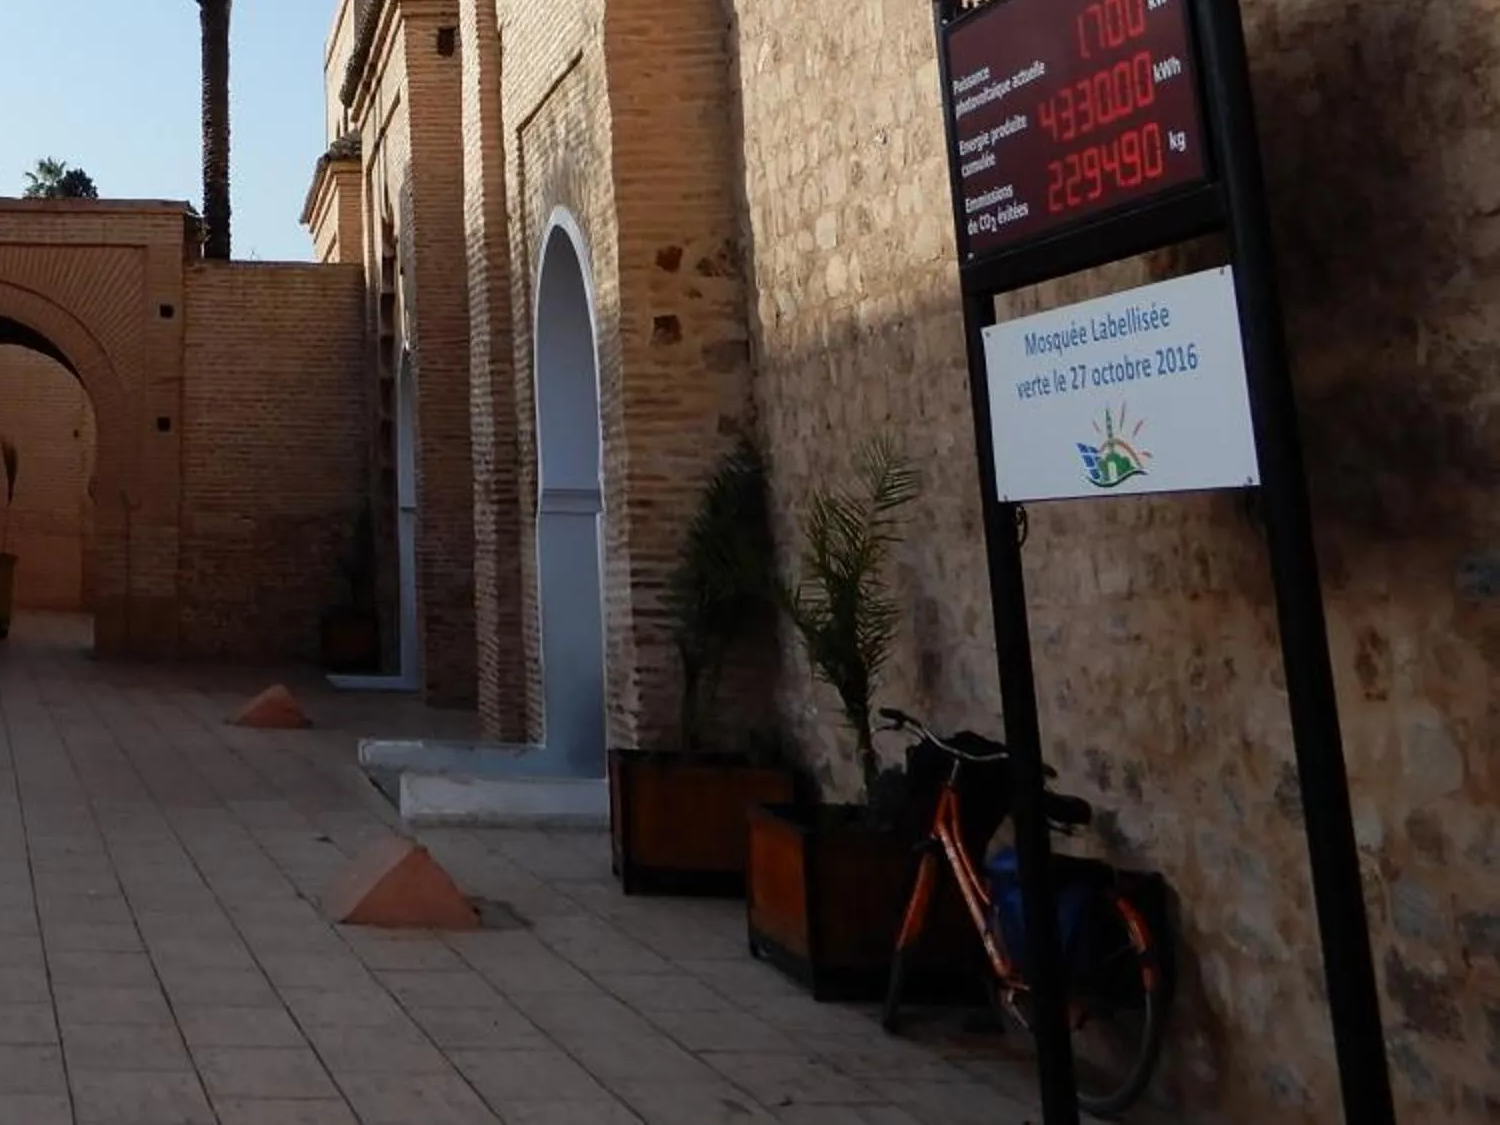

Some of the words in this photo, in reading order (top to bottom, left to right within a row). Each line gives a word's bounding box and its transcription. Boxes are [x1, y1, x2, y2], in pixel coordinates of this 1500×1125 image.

[952, 66, 990, 95] Puissance
[1011, 60, 1045, 89] actuelle
[1153, 55, 1182, 84] kWh
[991, 114, 1028, 147] produite
[1168, 130, 1186, 152] kg
[967, 216, 979, 236] de
[1024, 320, 1088, 357] Mosquée
[1091, 302, 1170, 342] Labellisée
[1016, 373, 1050, 400] verte
[1052, 370, 1067, 393] le
[1070, 364, 1087, 391] 27
[1091, 353, 1151, 387] octobre
[1156, 342, 1198, 376] 2016
